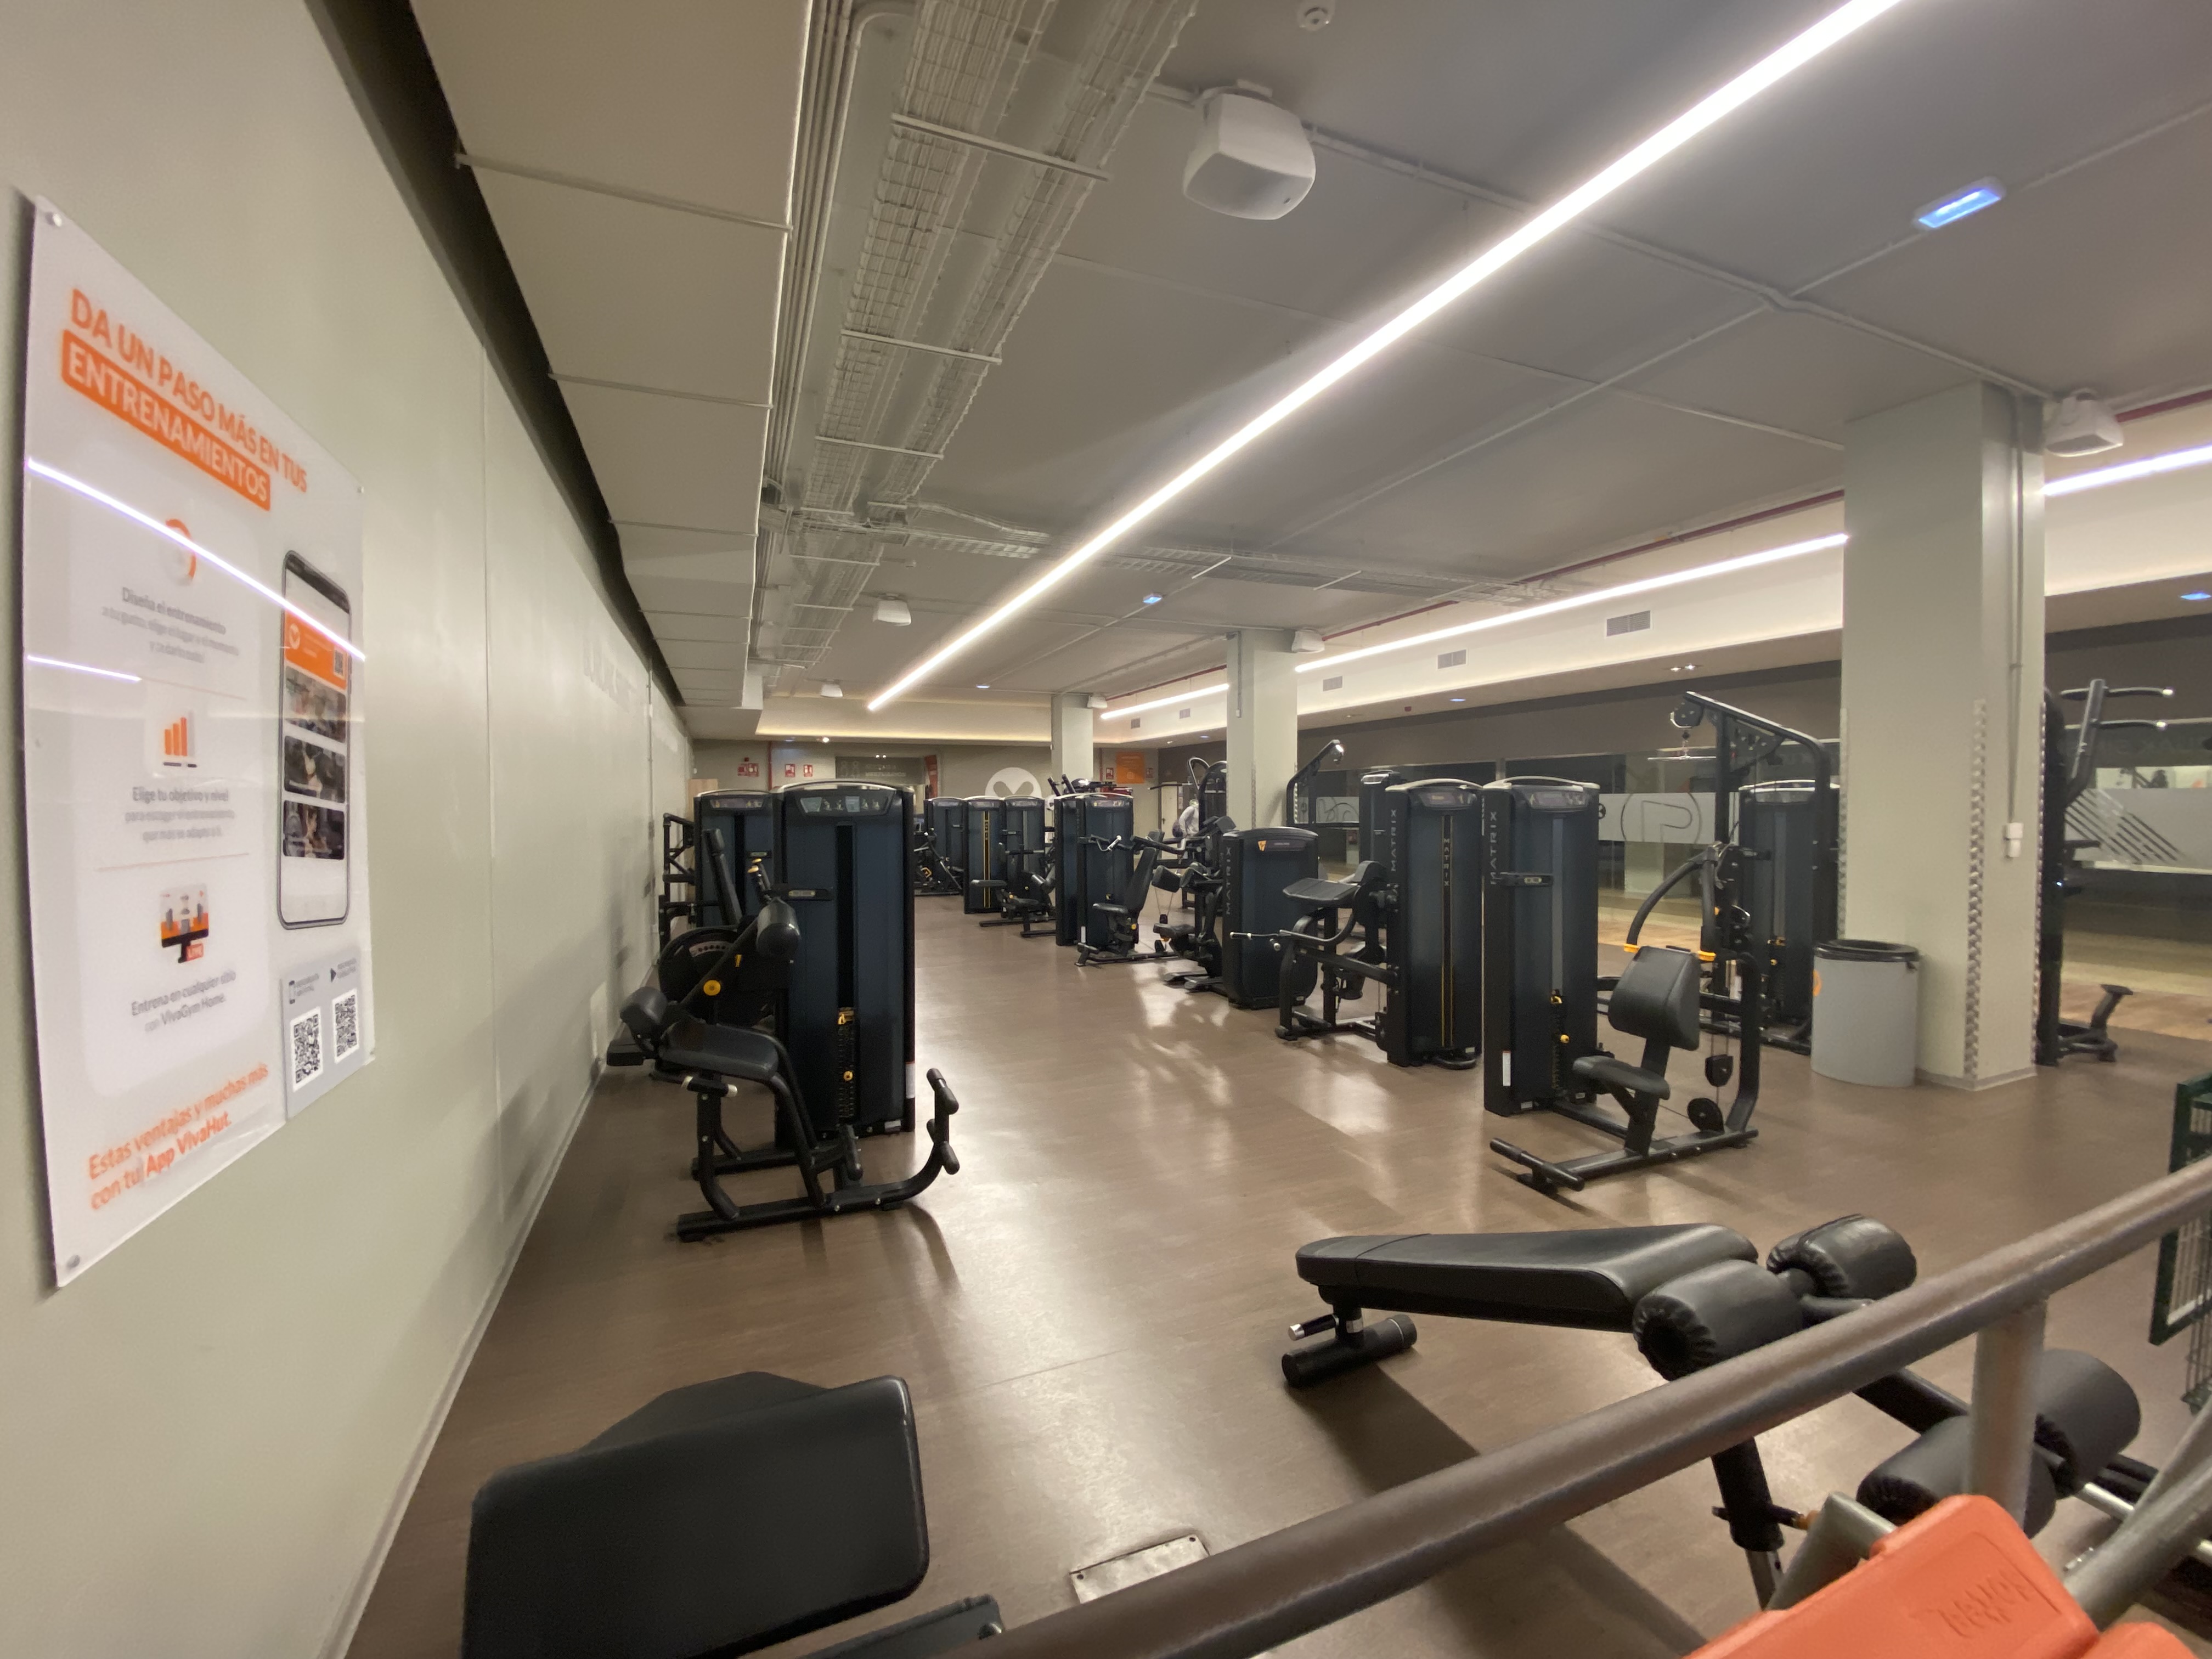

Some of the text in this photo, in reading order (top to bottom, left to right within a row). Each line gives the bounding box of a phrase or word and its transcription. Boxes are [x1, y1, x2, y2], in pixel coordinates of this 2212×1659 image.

[69, 340, 268, 503] ENTRENAMIENTOS
[72, 288, 307, 493] DA UN PASO MÁS EN TUS
[132, 787, 155, 804] Elige
[158, 788, 167, 801] tu
[169, 788, 203, 803] objetivo
[132, 995, 169, 1015] Entrena
[89, 1063, 268, 1180] Estas ventajas y muchas más
[91, 1180, 121, 1210] con
[123, 1167, 141, 1189] tu
[146, 1147, 175, 1178] App
